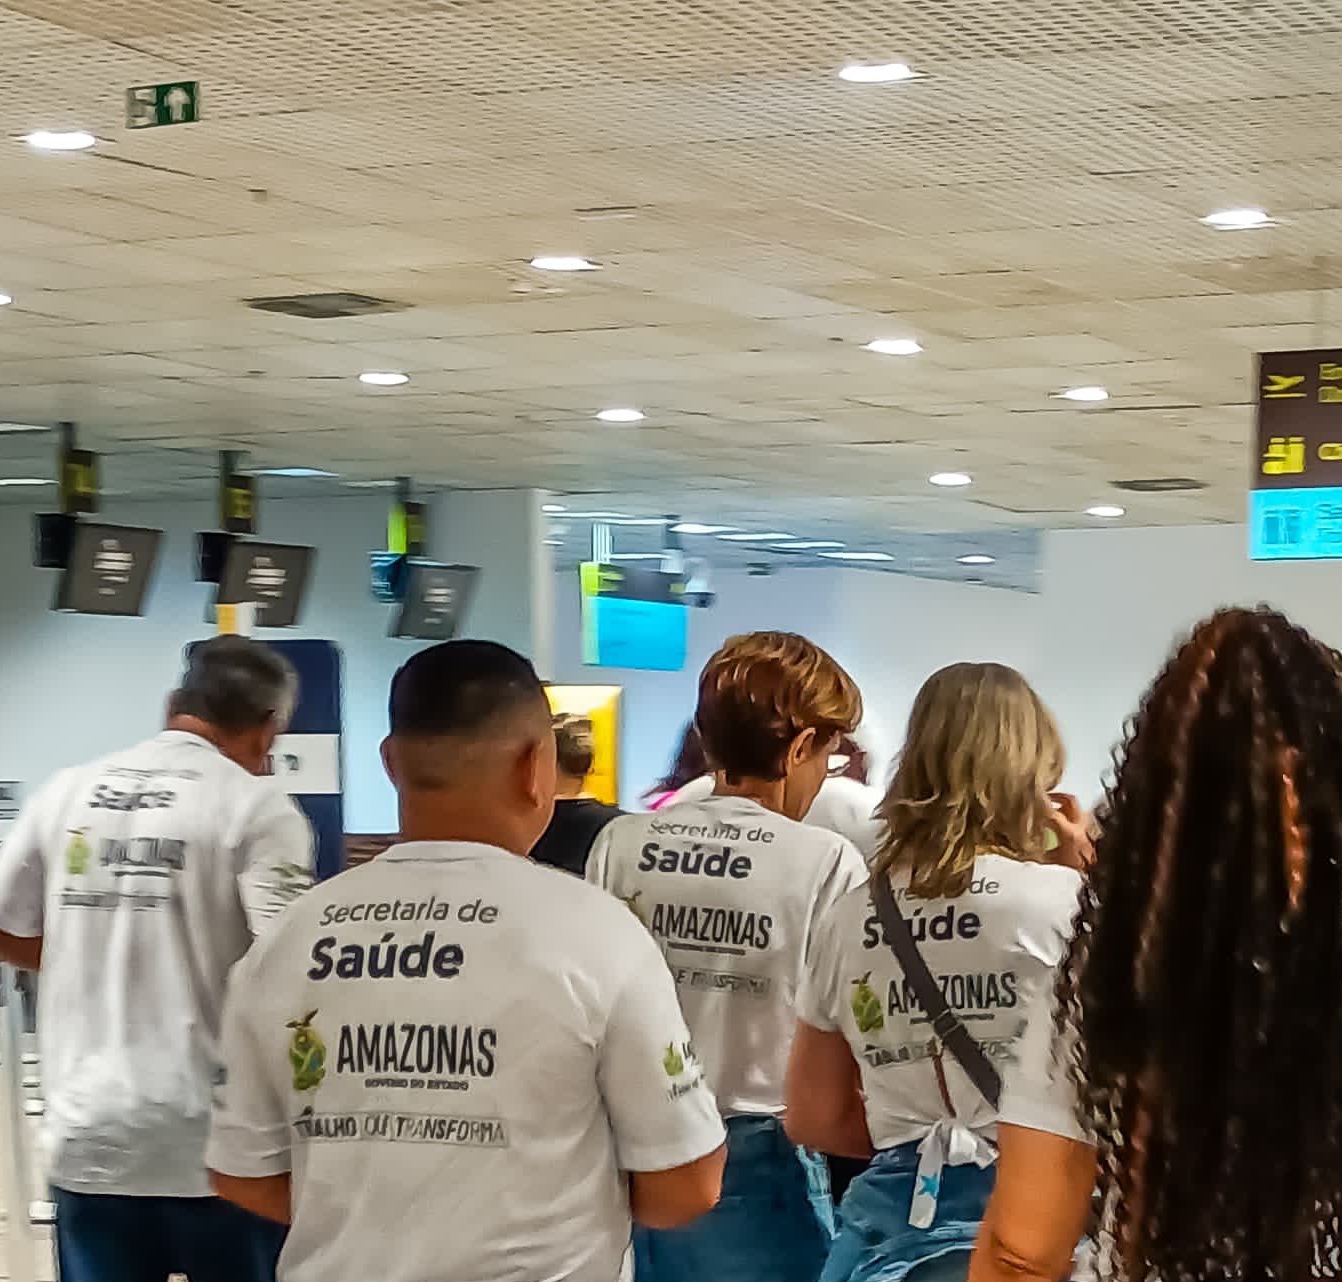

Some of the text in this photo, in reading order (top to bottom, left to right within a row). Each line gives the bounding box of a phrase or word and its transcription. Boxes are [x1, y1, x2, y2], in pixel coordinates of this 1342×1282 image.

[746, 823, 775, 844] de
[637, 841, 752, 879] Saúde
[969, 876, 1000, 895] de
[319, 896, 499, 927] Secretaria de
[651, 903, 773, 950] AMAZONAS
[862, 905, 981, 949] Súde
[307, 931, 464, 982] Saúde
[888, 971, 1018, 1017] AMZONAS
[336, 1022, 498, 1078] AMAZONAS
[396, 1115, 505, 1143] TRANSFORMA
